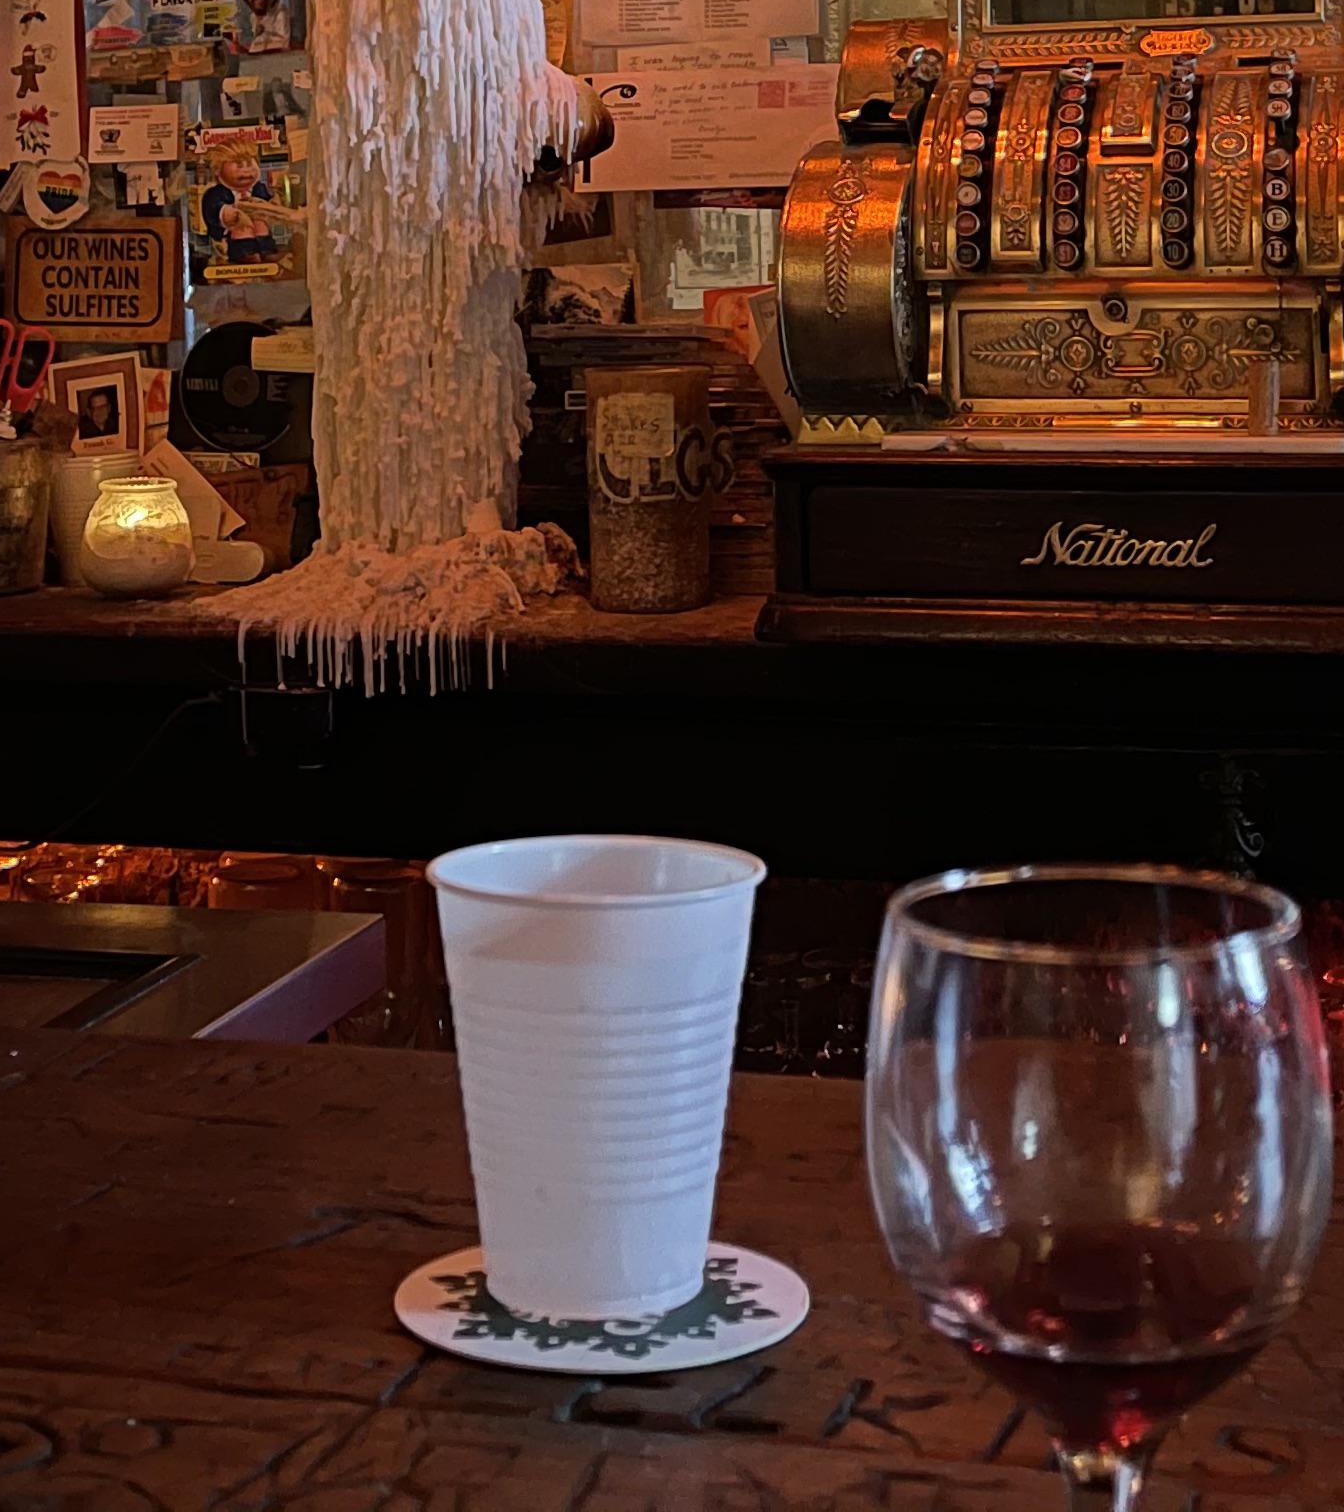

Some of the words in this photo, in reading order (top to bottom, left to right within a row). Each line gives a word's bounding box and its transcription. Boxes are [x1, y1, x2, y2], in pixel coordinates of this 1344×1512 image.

[32, 238, 79, 261] OUR
[84, 238, 149, 261] WINES
[41, 266, 139, 289] CONTAIN
[45, 294, 139, 318] SULFITES
[1021, 521, 1217, 569] National
